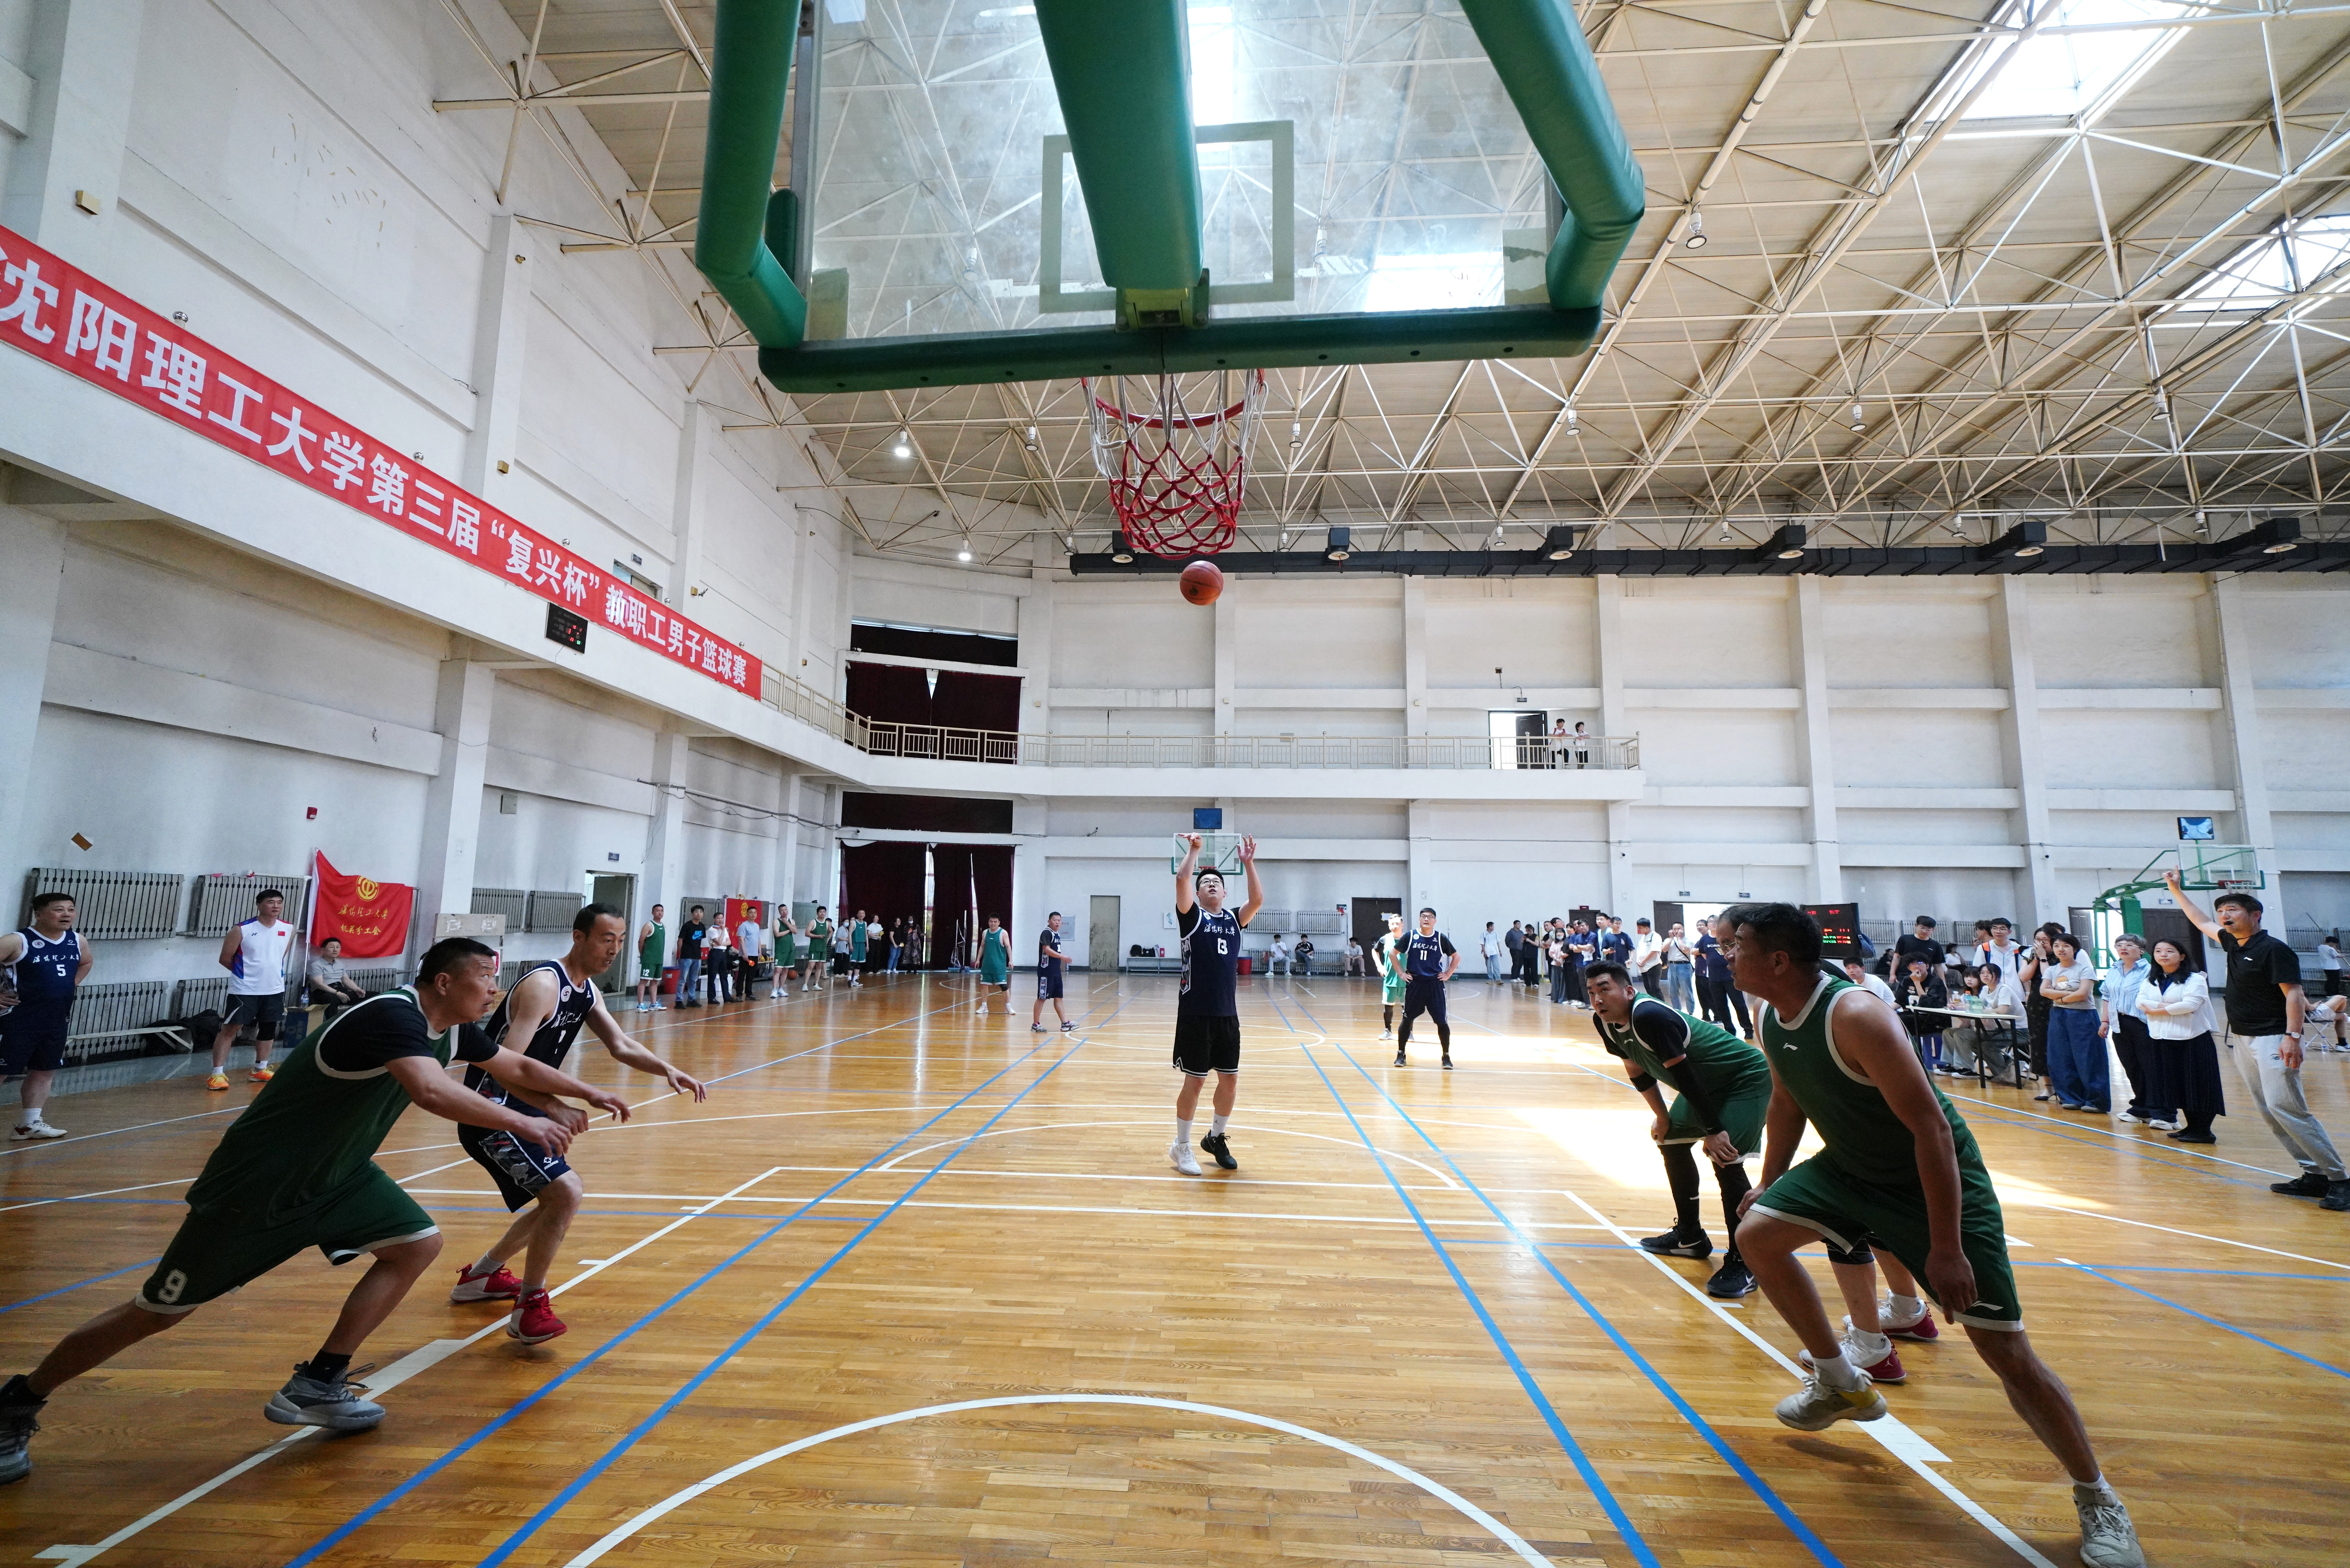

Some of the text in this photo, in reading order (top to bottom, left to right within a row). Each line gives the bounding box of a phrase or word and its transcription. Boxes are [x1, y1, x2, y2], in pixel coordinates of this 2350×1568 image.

[1217, 938, 1228, 955] 13
[1420, 950, 1427, 960] 11
[56, 964, 66, 977] 5
[157, 1269, 188, 1304] 9
